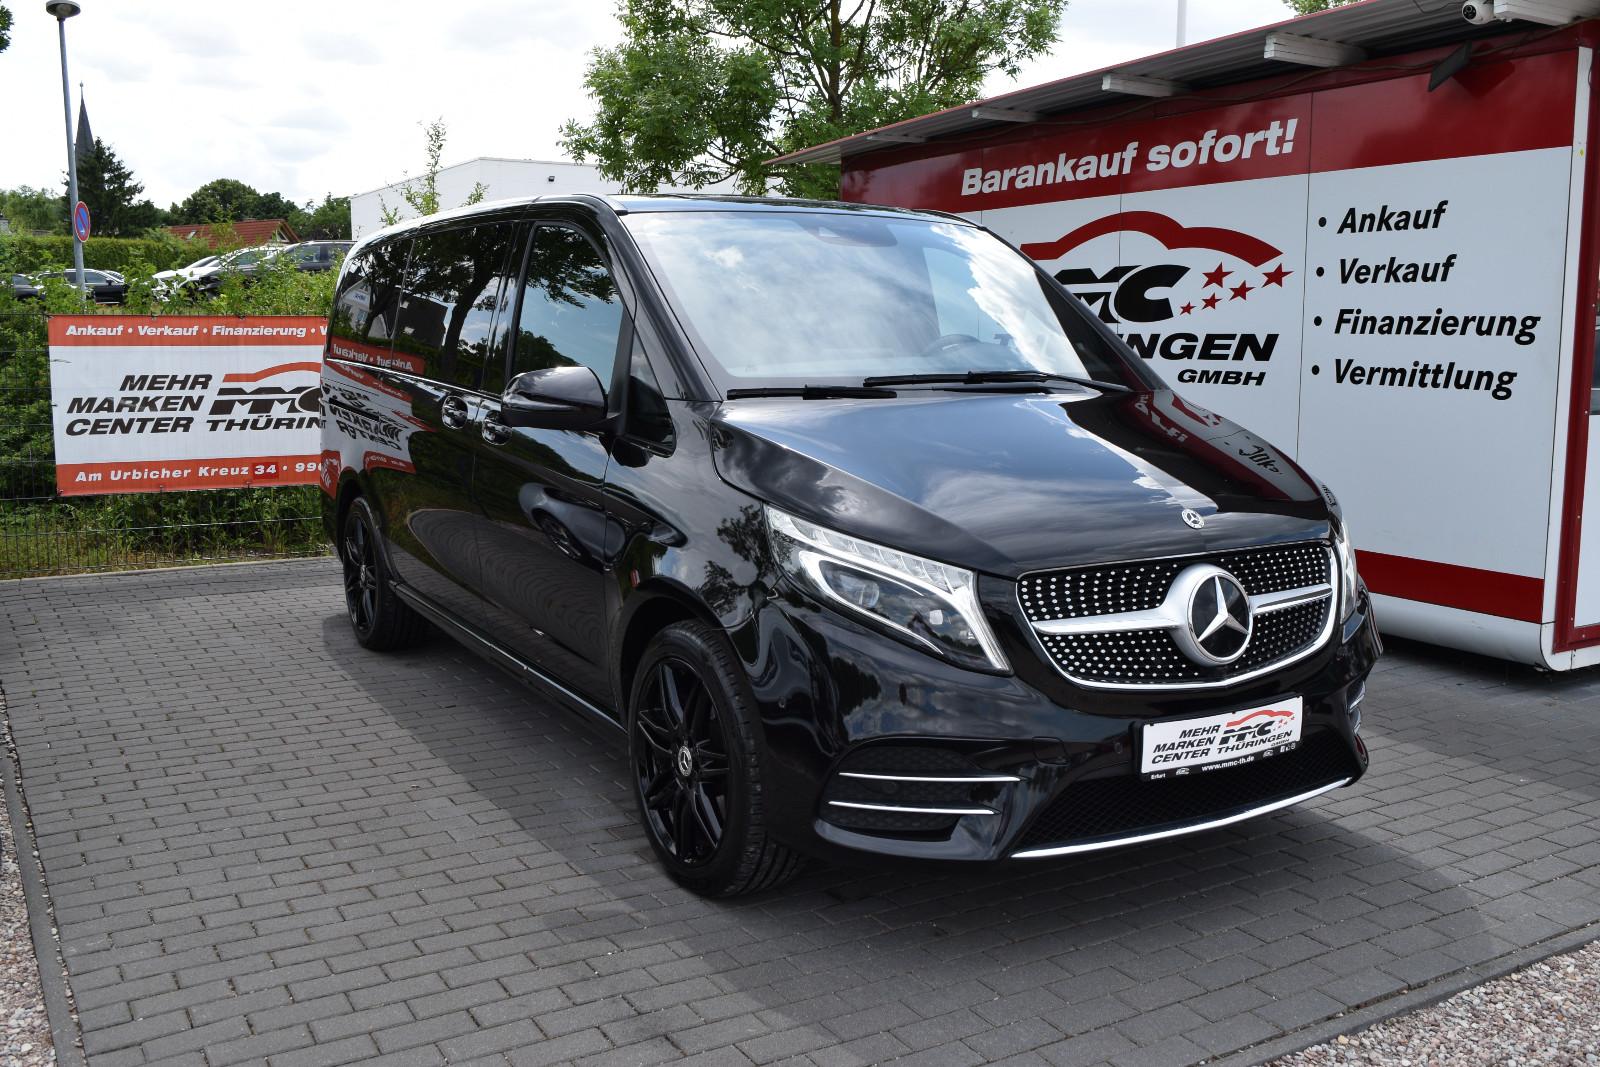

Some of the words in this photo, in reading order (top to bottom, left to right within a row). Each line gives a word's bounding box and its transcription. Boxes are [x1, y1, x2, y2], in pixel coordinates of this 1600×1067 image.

[961, 141, 1139, 197] Barankauf
[1145, 118, 1299, 172] sofort!
[1337, 200, 1449, 235] Ankauf
[1339, 254, 1457, 284] Verkauf
[1053, 264, 1192, 324] MC
[65, 325, 124, 336] Ankauf
[137, 325, 199, 336] Verkauf
[211, 325, 307, 338] Finanzierung
[1334, 307, 1541, 346] Finanzierung
[119, 374, 213, 391] MEHR
[1177, 369, 1267, 387] GMBH
[1334, 358, 1518, 401] Vermittlung
[66, 395, 205, 414] MARKEN
[65, 416, 195, 437] CENTER
[206, 414, 321, 432] THÜRIN
[75, 471, 102, 482] Am
[110, 468, 191, 481] Urbicher
[198, 466, 249, 477] Kreuz
[254, 464, 277, 475] 34
[1179, 724, 1221, 739] MEHR
[1151, 747, 1211, 764] CENTER
[1216, 729, 1293, 755] THÜRINGEN
[1152, 736, 1216, 754] MARKEN
[1201, 755, 1255, 772] www.mmc-th.de
